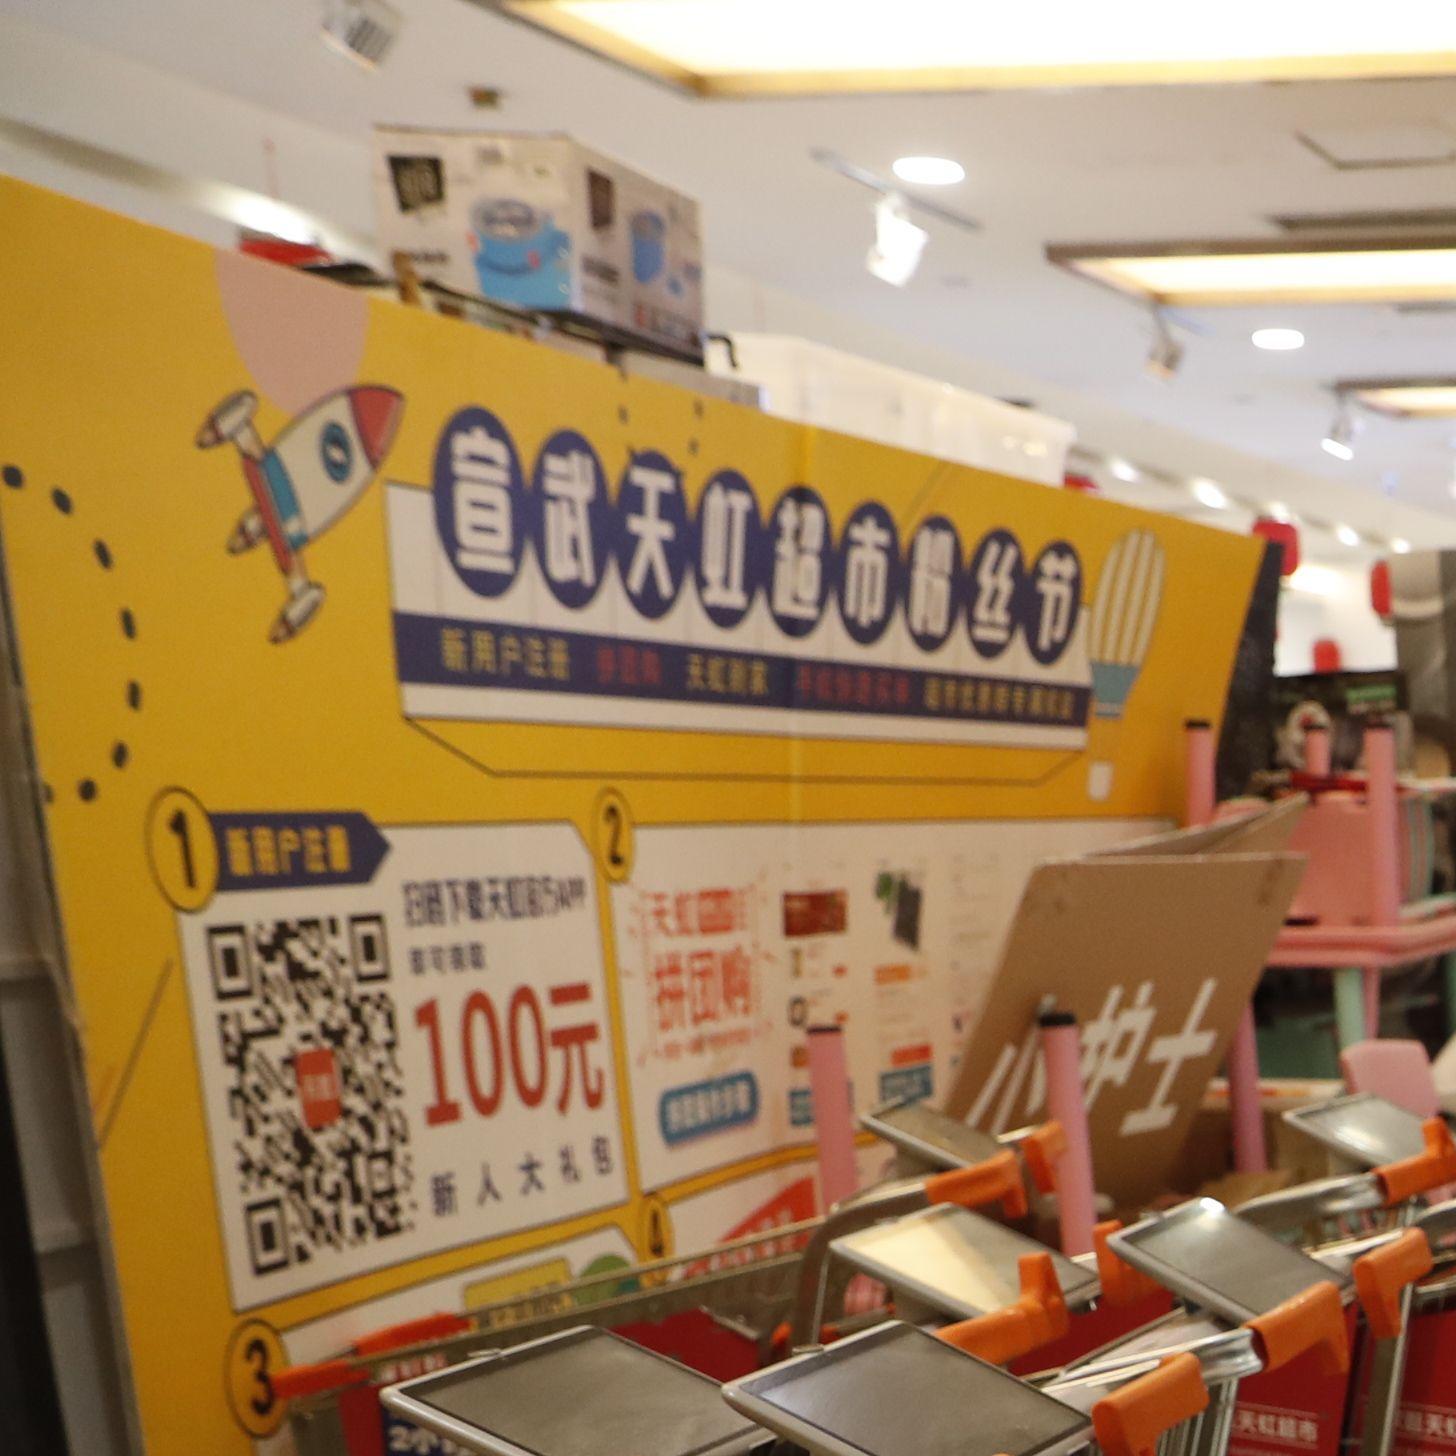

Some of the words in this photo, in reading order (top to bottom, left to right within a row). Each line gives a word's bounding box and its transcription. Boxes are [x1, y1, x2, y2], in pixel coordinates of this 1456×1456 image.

[451, 424, 1077, 651] 宣武天虹超市粉丝节
[169, 810, 196, 888] 1
[414, 981, 605, 1128] 100元
[431, 1136, 614, 1217] 新人大礼包
[243, 1339, 275, 1416] 3
